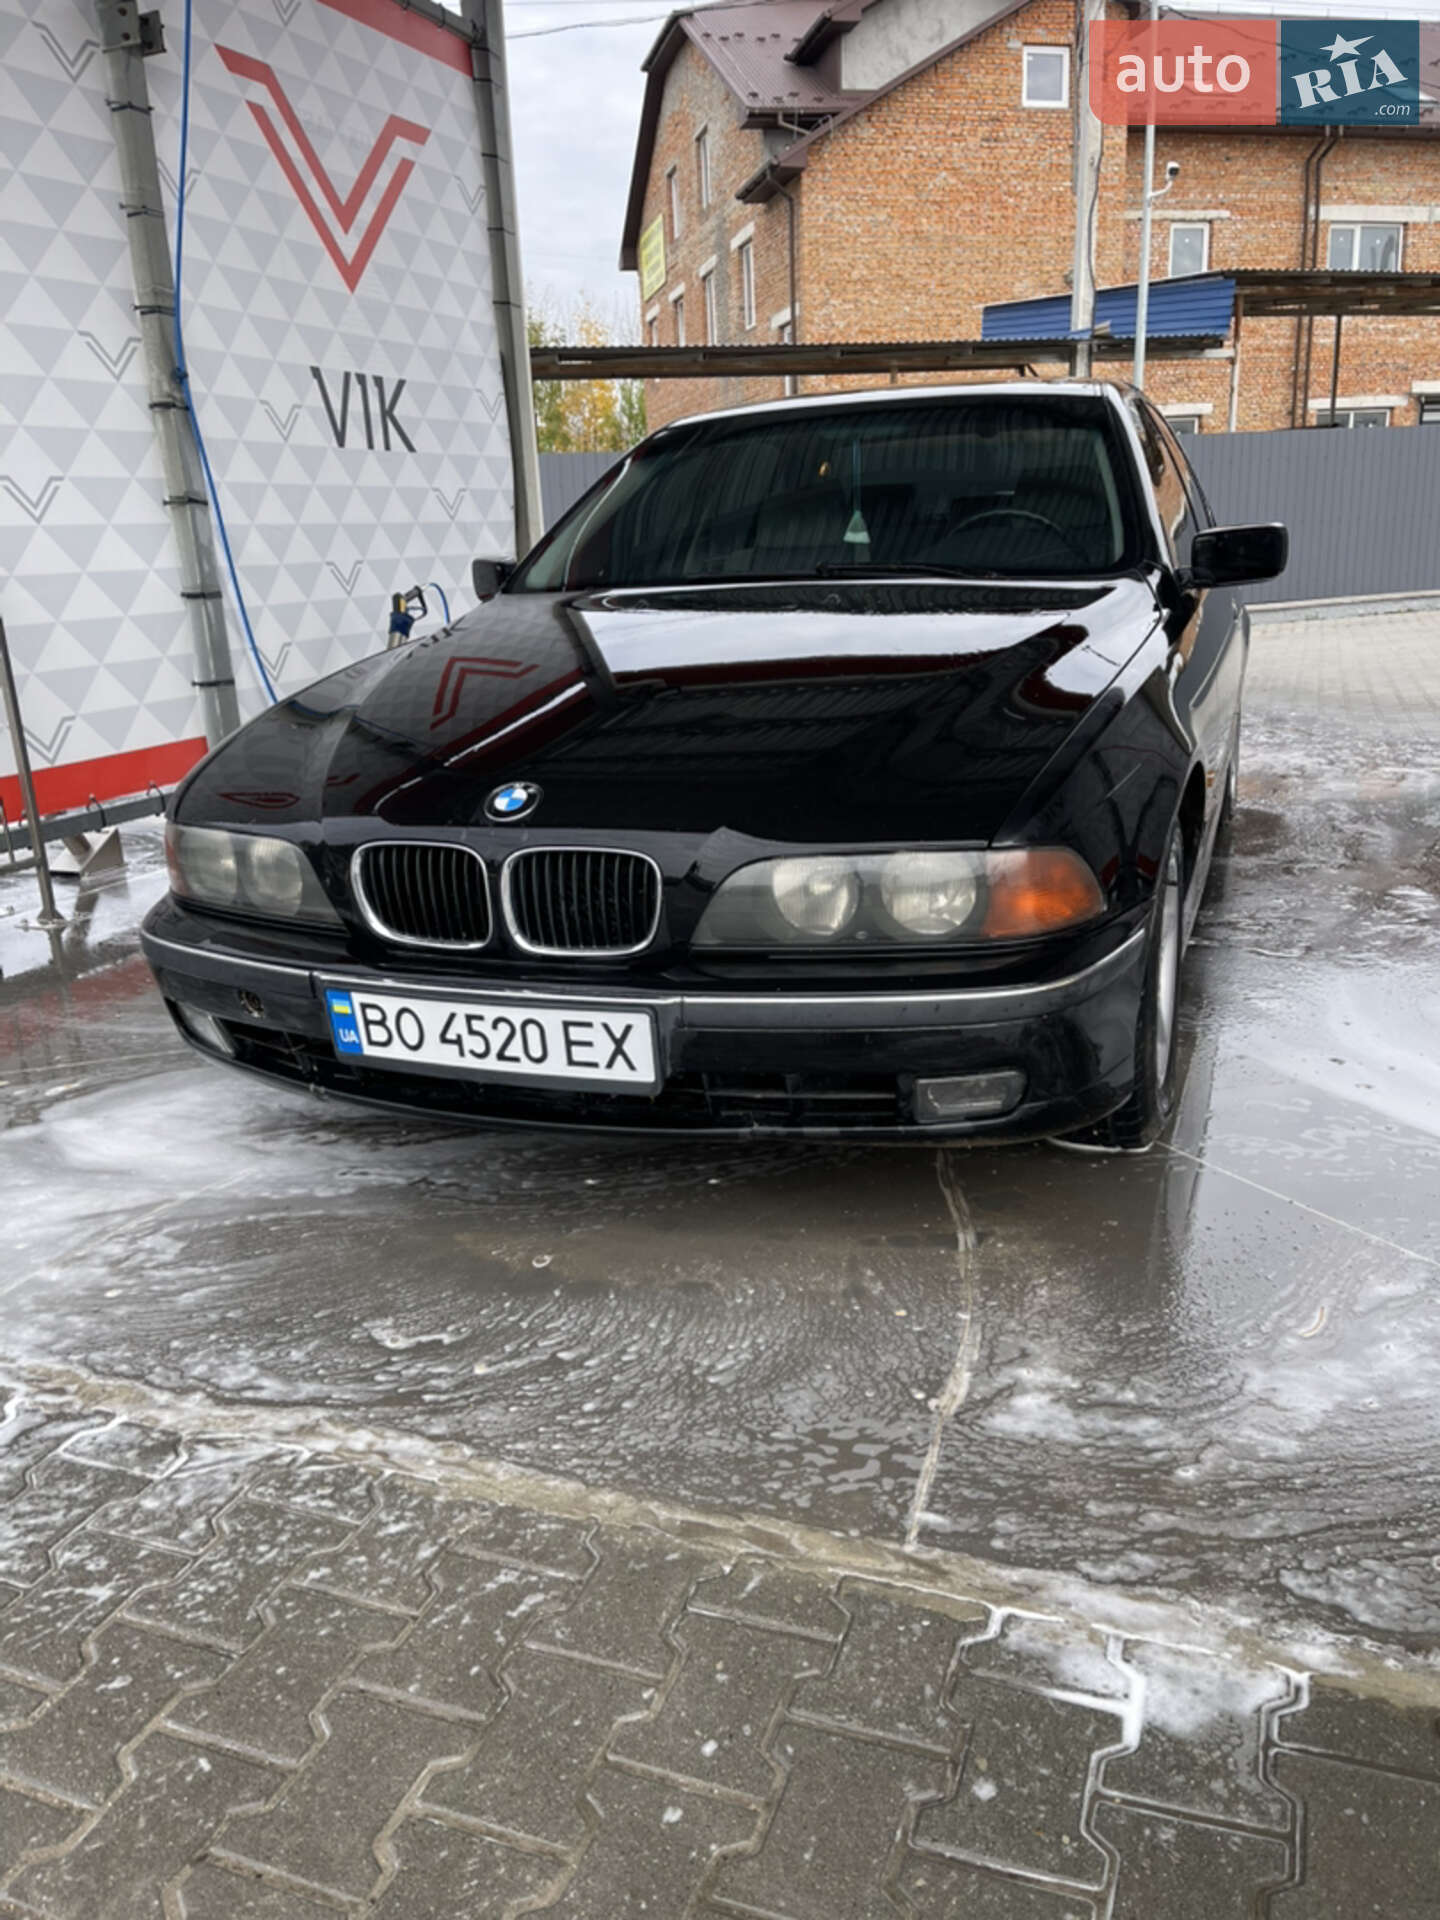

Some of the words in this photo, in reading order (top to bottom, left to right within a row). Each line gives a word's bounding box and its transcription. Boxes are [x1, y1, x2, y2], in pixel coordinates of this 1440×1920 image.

[309, 365, 416, 453] VIK
[339, 1029, 359, 1044] UA
[359, 1002, 425, 1051] BO
[439, 1012, 548, 1064] 4520
[561, 1020, 637, 1071] EX
